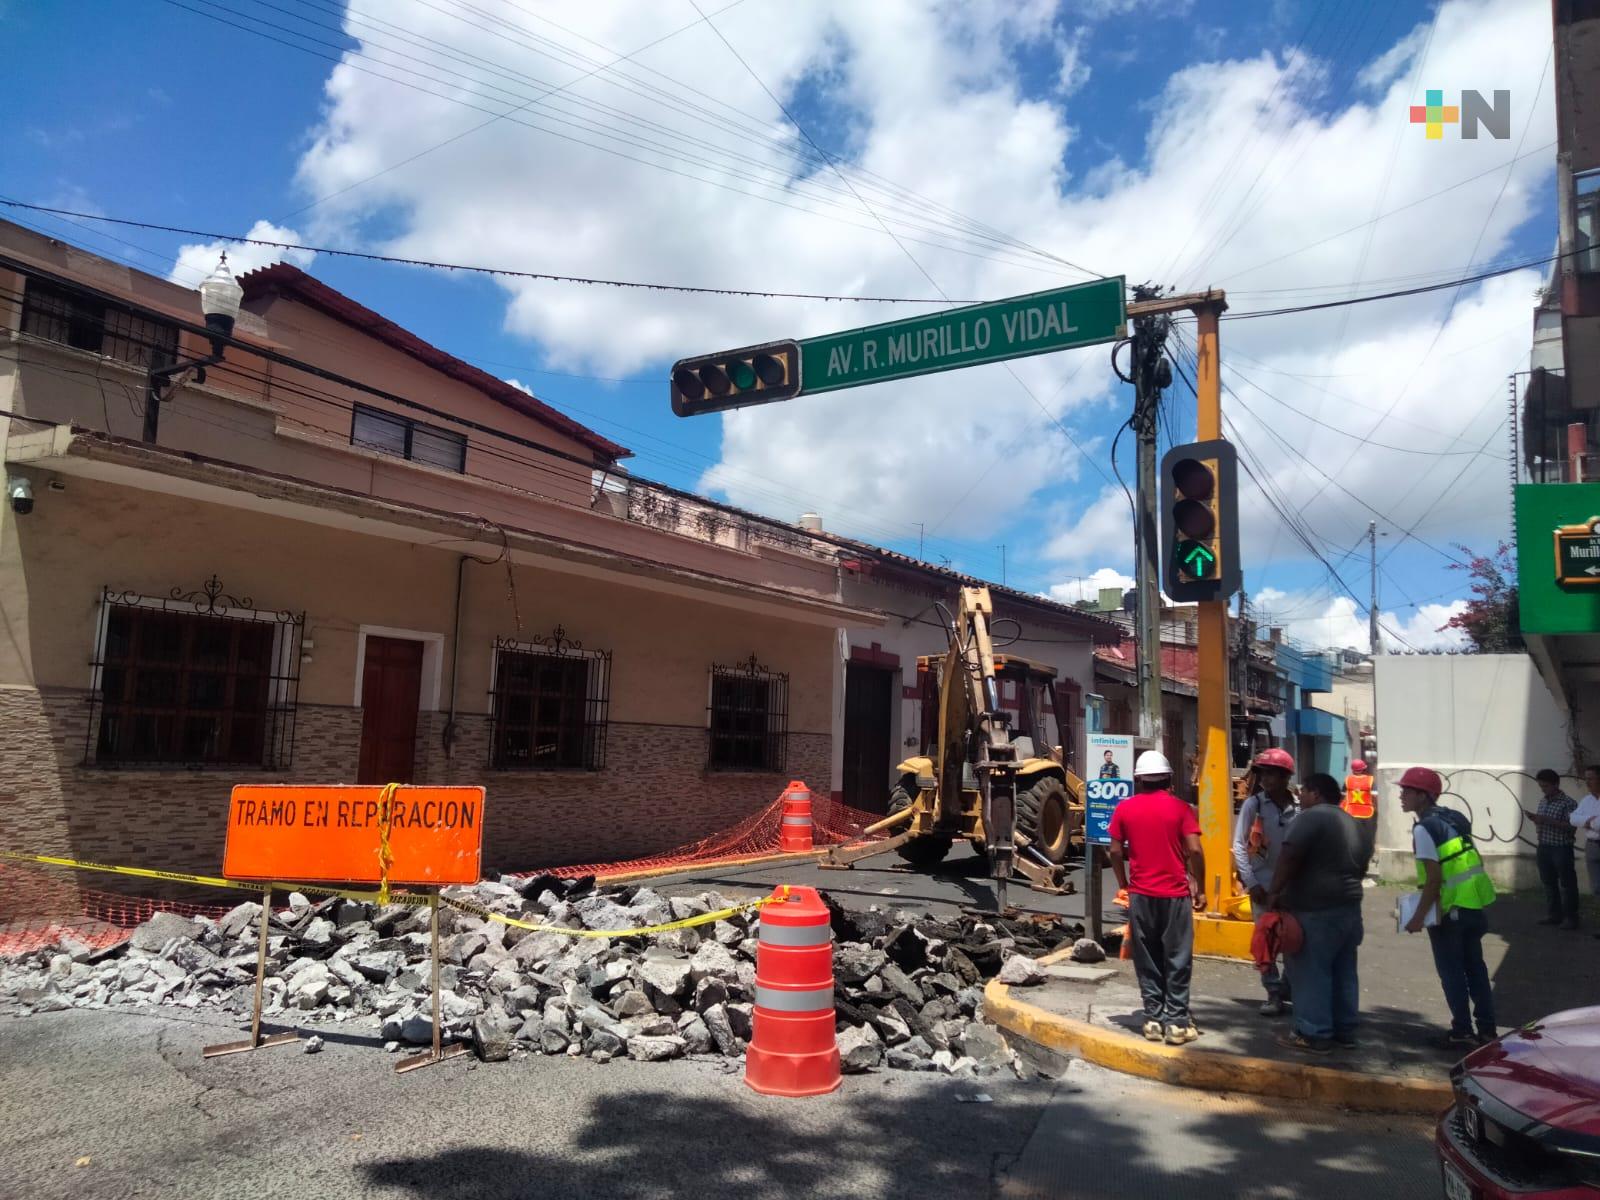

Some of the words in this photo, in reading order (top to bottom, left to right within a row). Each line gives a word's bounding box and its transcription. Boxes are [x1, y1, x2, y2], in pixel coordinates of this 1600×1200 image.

[827, 343, 859, 377] AV.
[1001, 301, 1079, 344] VIDAL
[1091, 736, 1129, 745] infinitum
[1087, 781, 1129, 800] 300
[237, 799, 297, 827] TRAMO
[303, 800, 329, 827] EN
[337, 799, 475, 829] REPARACION
